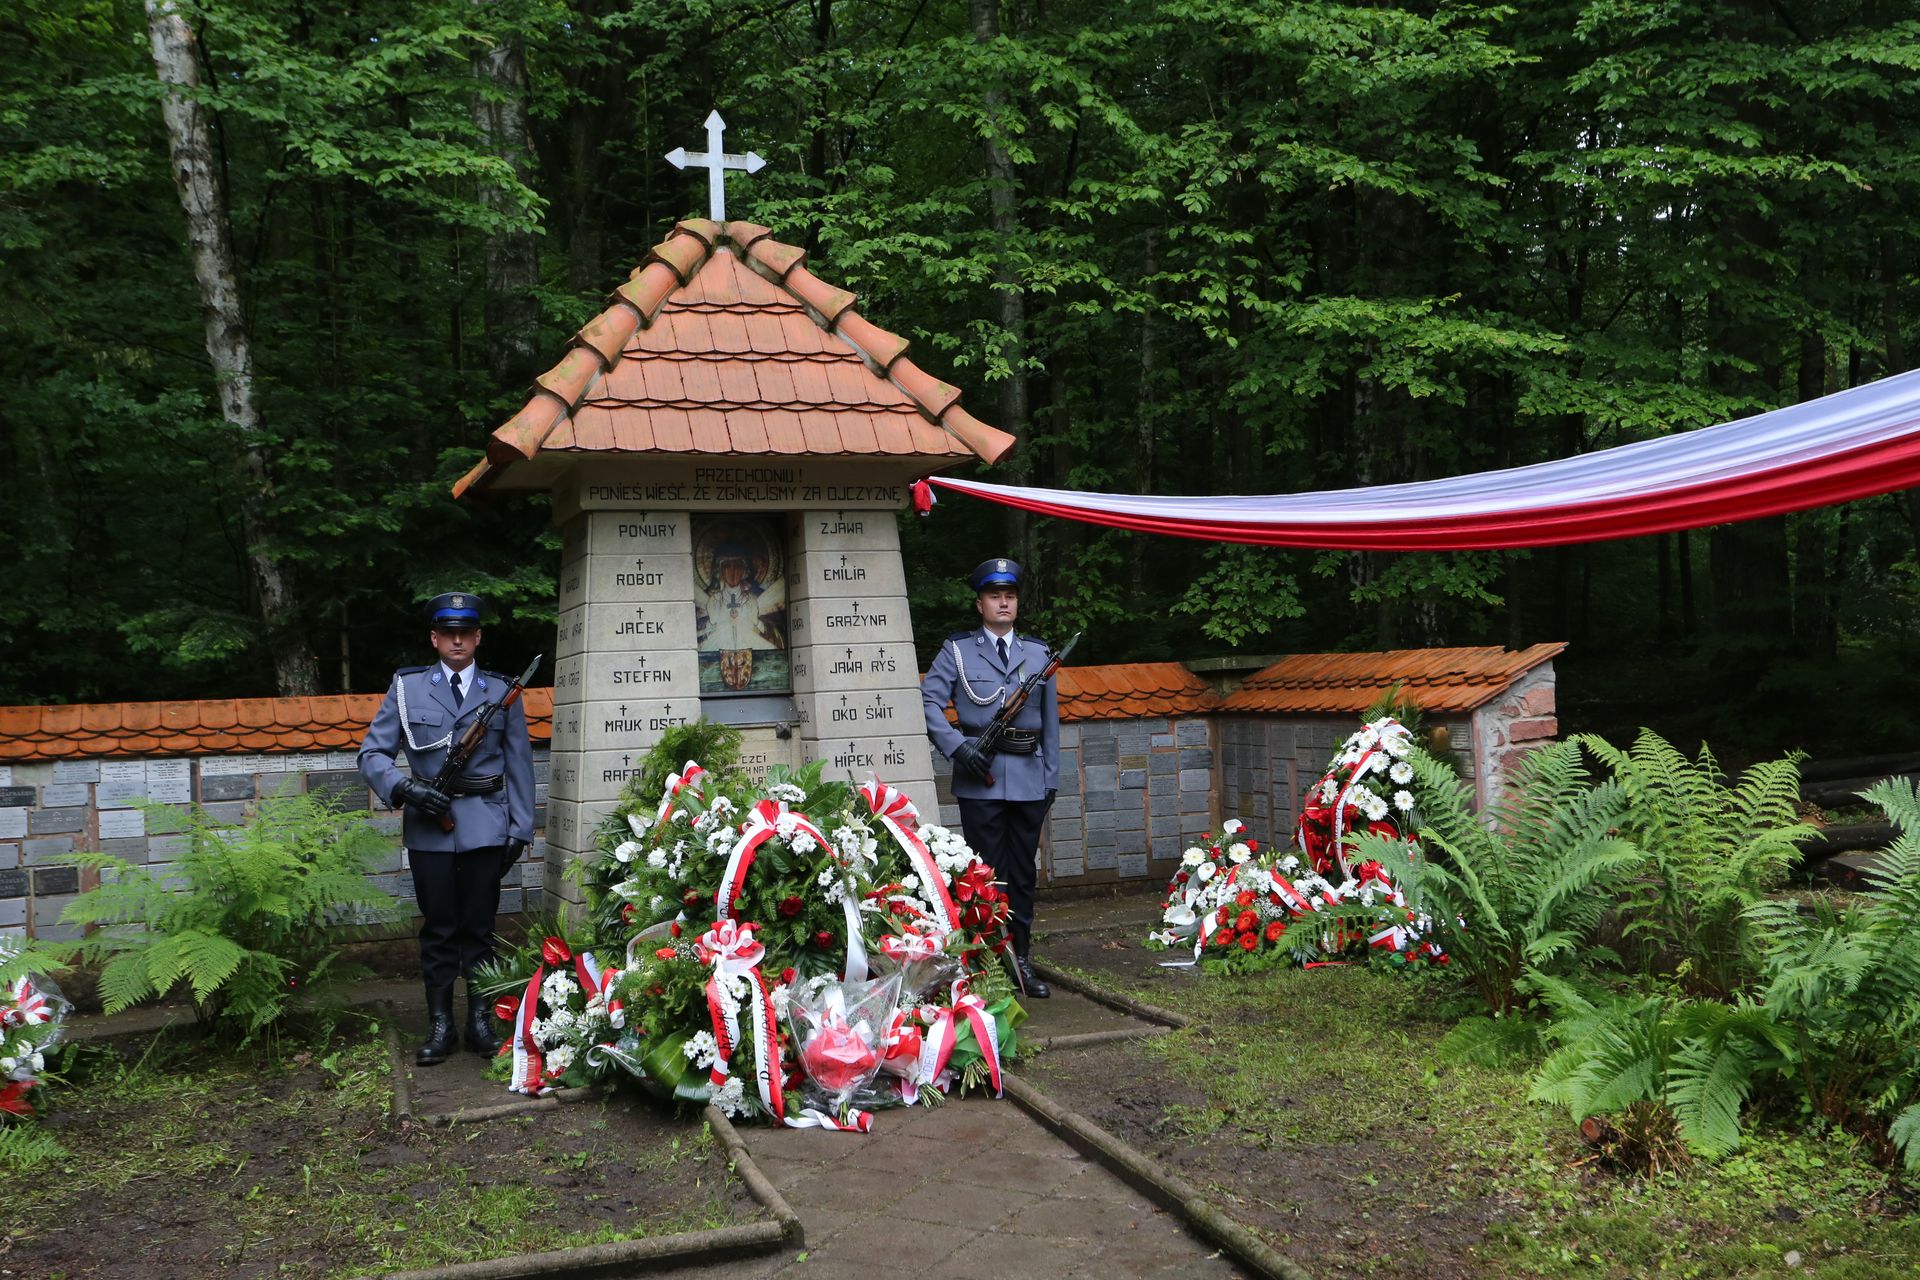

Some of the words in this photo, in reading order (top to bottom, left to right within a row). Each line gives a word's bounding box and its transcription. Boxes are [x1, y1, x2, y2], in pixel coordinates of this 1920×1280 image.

[695, 468, 794, 483] PRZECHODNIU
[693, 483, 711, 500] ŻE
[802, 486, 821, 501] ZA
[827, 485, 901, 504] OJCZYZNĘ
[618, 524, 677, 538] PONURY
[820, 522, 864, 535] ZJAWA
[616, 573, 664, 587] ROBOT
[823, 566, 866, 581] EMILIA
[826, 612, 887, 628] GRAŻYNA
[615, 621, 665, 635] JACEK
[830, 661, 863, 674] JAWA
[871, 656, 896, 672] RYŚ
[613, 669, 672, 684] STEFAN
[832, 708, 857, 722] OKO
[865, 703, 894, 720] ŚWIT
[605, 719, 642, 733] MRUK
[741, 752, 767, 764] CZCI
[834, 751, 874, 768] HIPEK
[884, 749, 905, 766] MIŚ
[753, 765, 765, 775] NA
